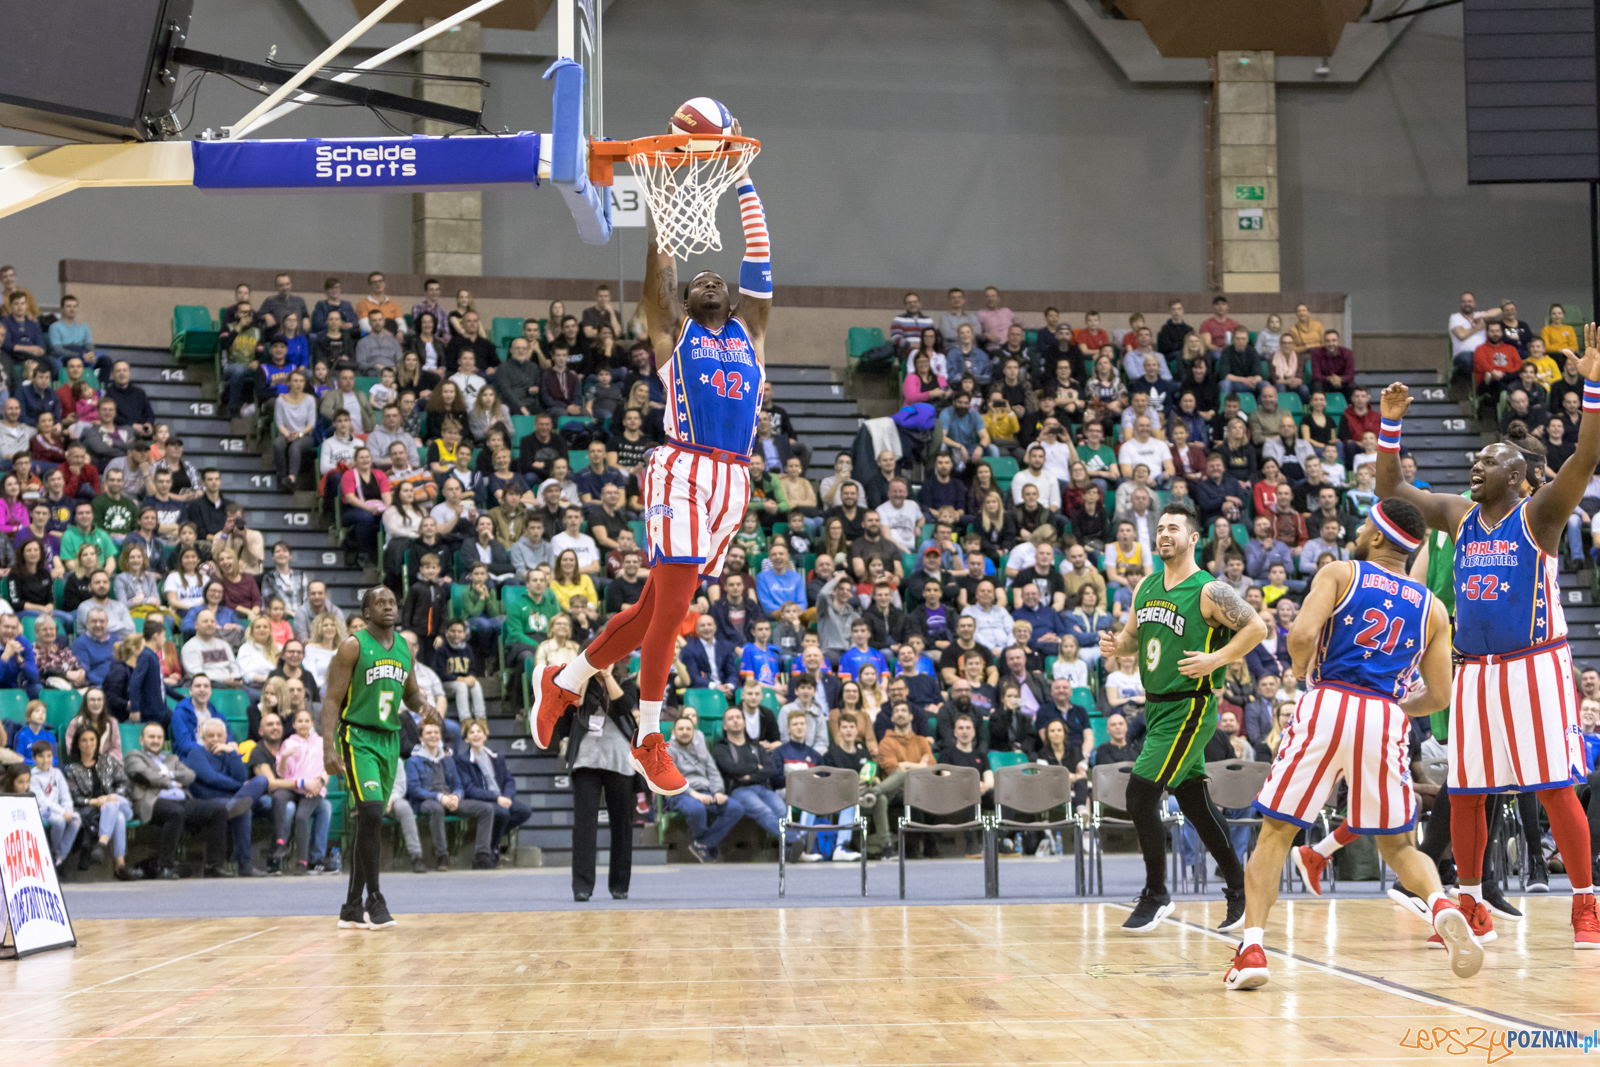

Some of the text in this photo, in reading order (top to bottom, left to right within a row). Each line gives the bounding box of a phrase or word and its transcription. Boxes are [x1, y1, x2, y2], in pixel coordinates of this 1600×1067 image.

[315, 144, 417, 161] Schelde
[315, 161, 417, 182] Sports
[161, 369, 185, 381] 14
[711, 368, 743, 400] 42
[1422, 388, 1446, 399] 14
[189, 403, 213, 415] 13
[1442, 419, 1466, 430] 13
[219, 439, 244, 451] 12
[251, 475, 272, 487] 11
[284, 513, 308, 525] 10
[1466, 540, 1509, 556] HARLEM
[1362, 574, 1423, 609] LIGHTS OUT
[1467, 574, 1499, 601] 52
[1145, 599, 1177, 612] WASHINGTON
[1137, 606, 1185, 637] GENERALS
[1354, 607, 1405, 656] 21
[375, 658, 402, 667] WASHINGTON
[1146, 637, 1161, 672] 9
[379, 690, 395, 722] 5
[511, 738, 528, 751] 4
[554, 775, 570, 788] 3
[3, 828, 46, 889] HARLEM
[9, 885, 66, 936] GLOBETROTTERS
